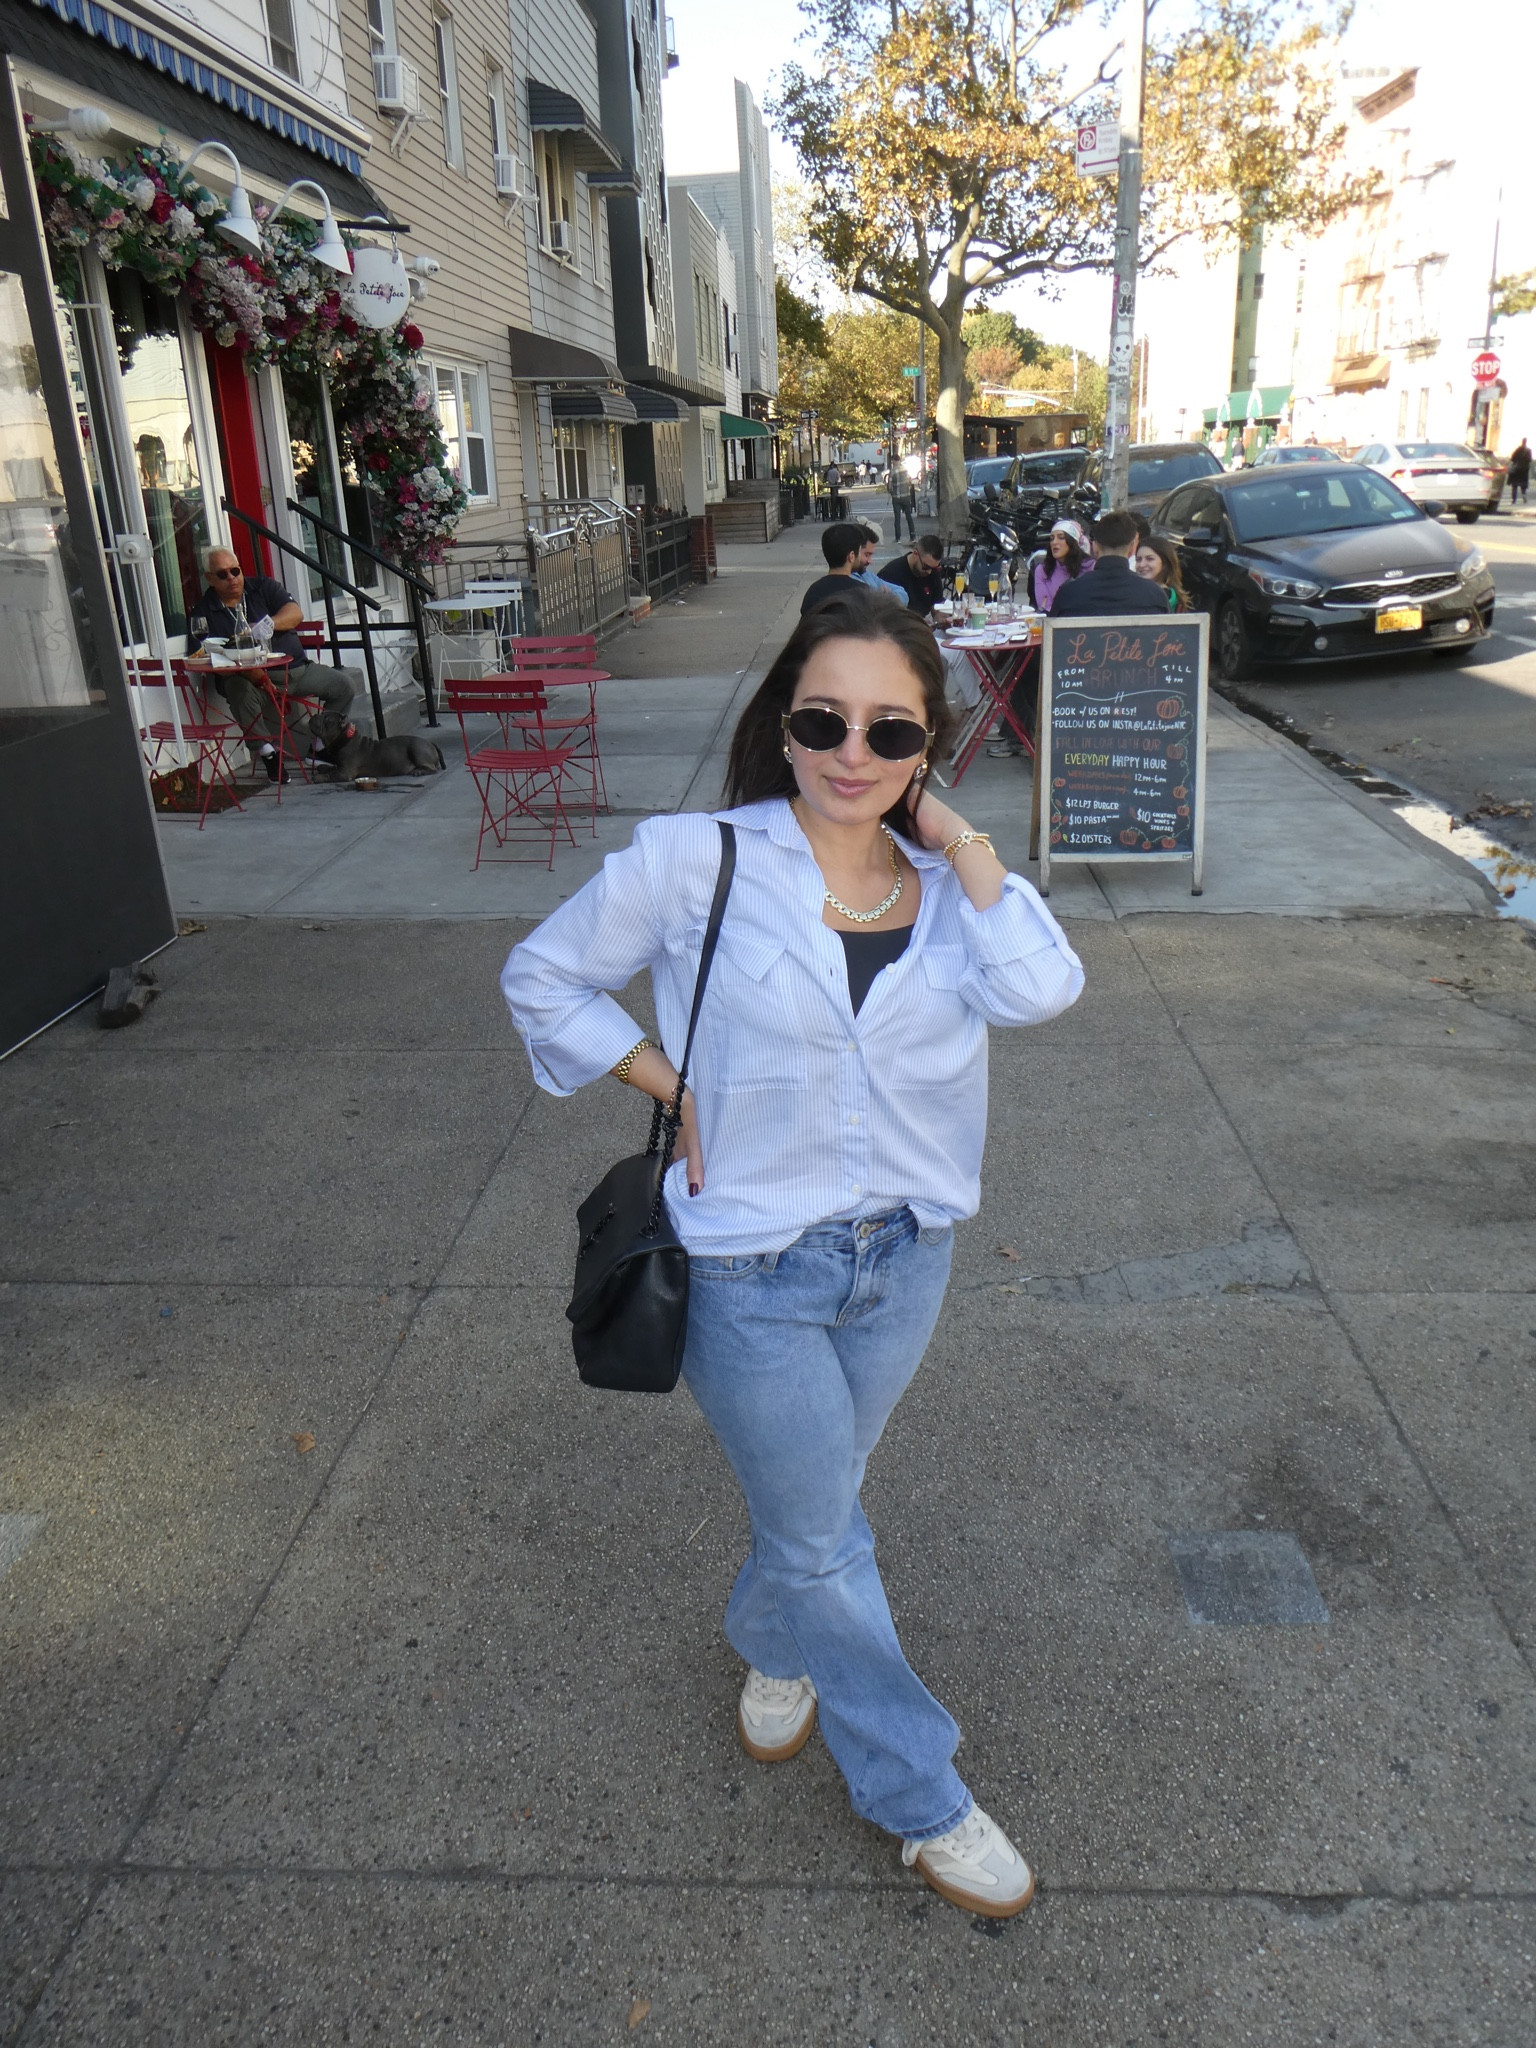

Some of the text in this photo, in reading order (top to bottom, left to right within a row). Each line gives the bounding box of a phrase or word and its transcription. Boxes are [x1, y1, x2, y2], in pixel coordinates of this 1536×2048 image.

[344, 282, 405, 304] La Petite Joie
[1472, 361, 1500, 375] STOP
[1066, 631, 1186, 668] La Petite Joie
[1058, 668, 1085, 679] FROM
[1162, 665, 1191, 673] TILL
[1090, 667, 1157, 688] BRUNCH
[1054, 708, 1075, 716] BOOK
[1100, 707, 1110, 715] ON
[1099, 720, 1109, 728] ON
[1142, 739, 1161, 752] OUR
[1064, 754, 1167, 770] EVERYDAY HAPPY HOUR
[1066, 798, 1119, 810] $12 LPJ BURGER
[1069, 814, 1082, 825] $10
[1084, 815, 1106, 825] PASTA
[1136, 808, 1151, 823] $10
[1082, 834, 1112, 844] OYSTERS
